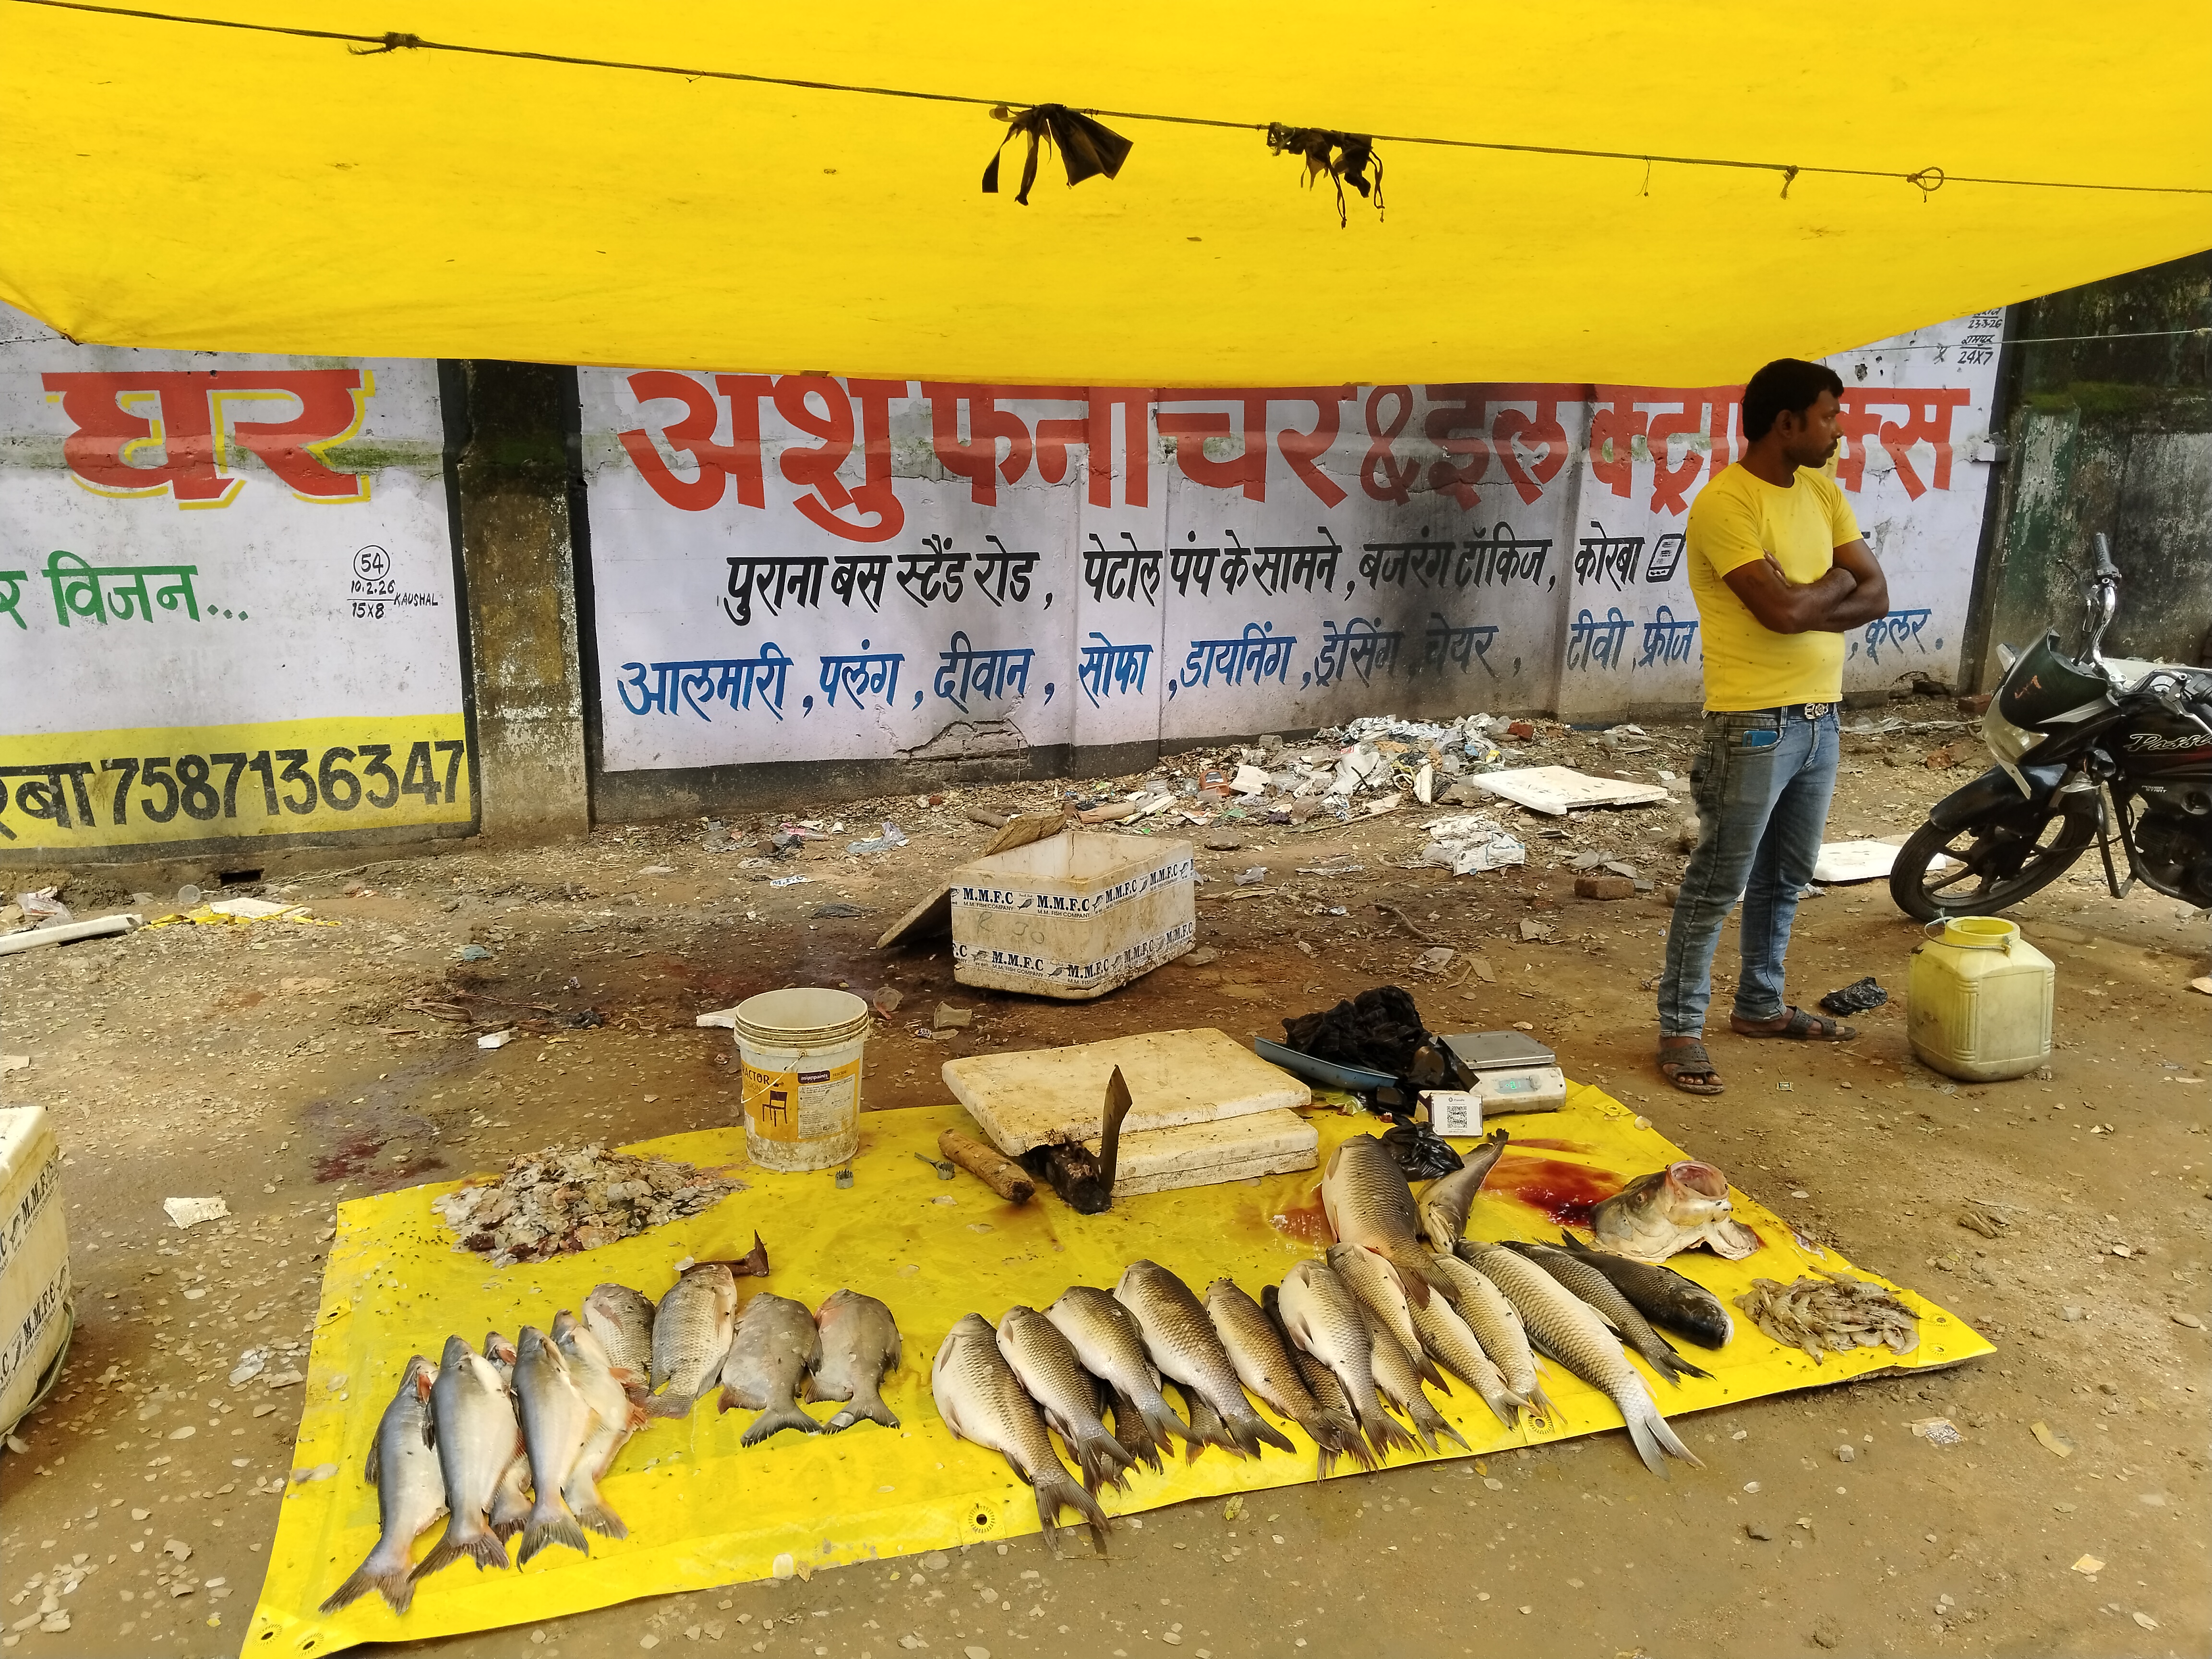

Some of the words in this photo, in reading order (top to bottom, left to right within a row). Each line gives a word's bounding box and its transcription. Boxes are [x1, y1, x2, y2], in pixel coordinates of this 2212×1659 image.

[41, 369, 371, 506] घर
[617, 370, 908, 542] अशु
[1360, 385, 1421, 506] &
[361, 553, 384, 575] 54
[723, 555, 829, 626] पुराना
[831, 555, 893, 613] बस
[896, 534, 972, 608] स्टैंड
[1169, 530, 1221, 598] पंप
[1358, 525, 1456, 590] बजरंग
[1574, 521, 1646, 592] कोरबा
[393, 592, 438, 607] KAUSHAL
[2123, 733, 2212, 752] Passi
[100, 740, 465, 826] 7587136347
[1150, 864, 1178, 886] M.M.F.C
[962, 888, 1013, 905] M.M.F.C
[1105, 879, 1137, 903] M.M.F.C
[1037, 895, 1090, 912] M.M.F.C
[1166, 922, 1193, 945] M.M.F.C
[992, 951, 1044, 971] M.M.F.C
[1124, 939, 1154, 963] M.M.F.C
[1017, 968, 1044, 978] COMPANY
[1068, 959, 1109, 979] M.M.F.C
[39, 1184, 55, 1213] COMPANY
[23, 1279, 56, 1346] M.M.F.C
[41, 1303, 57, 1333] COMPANY
